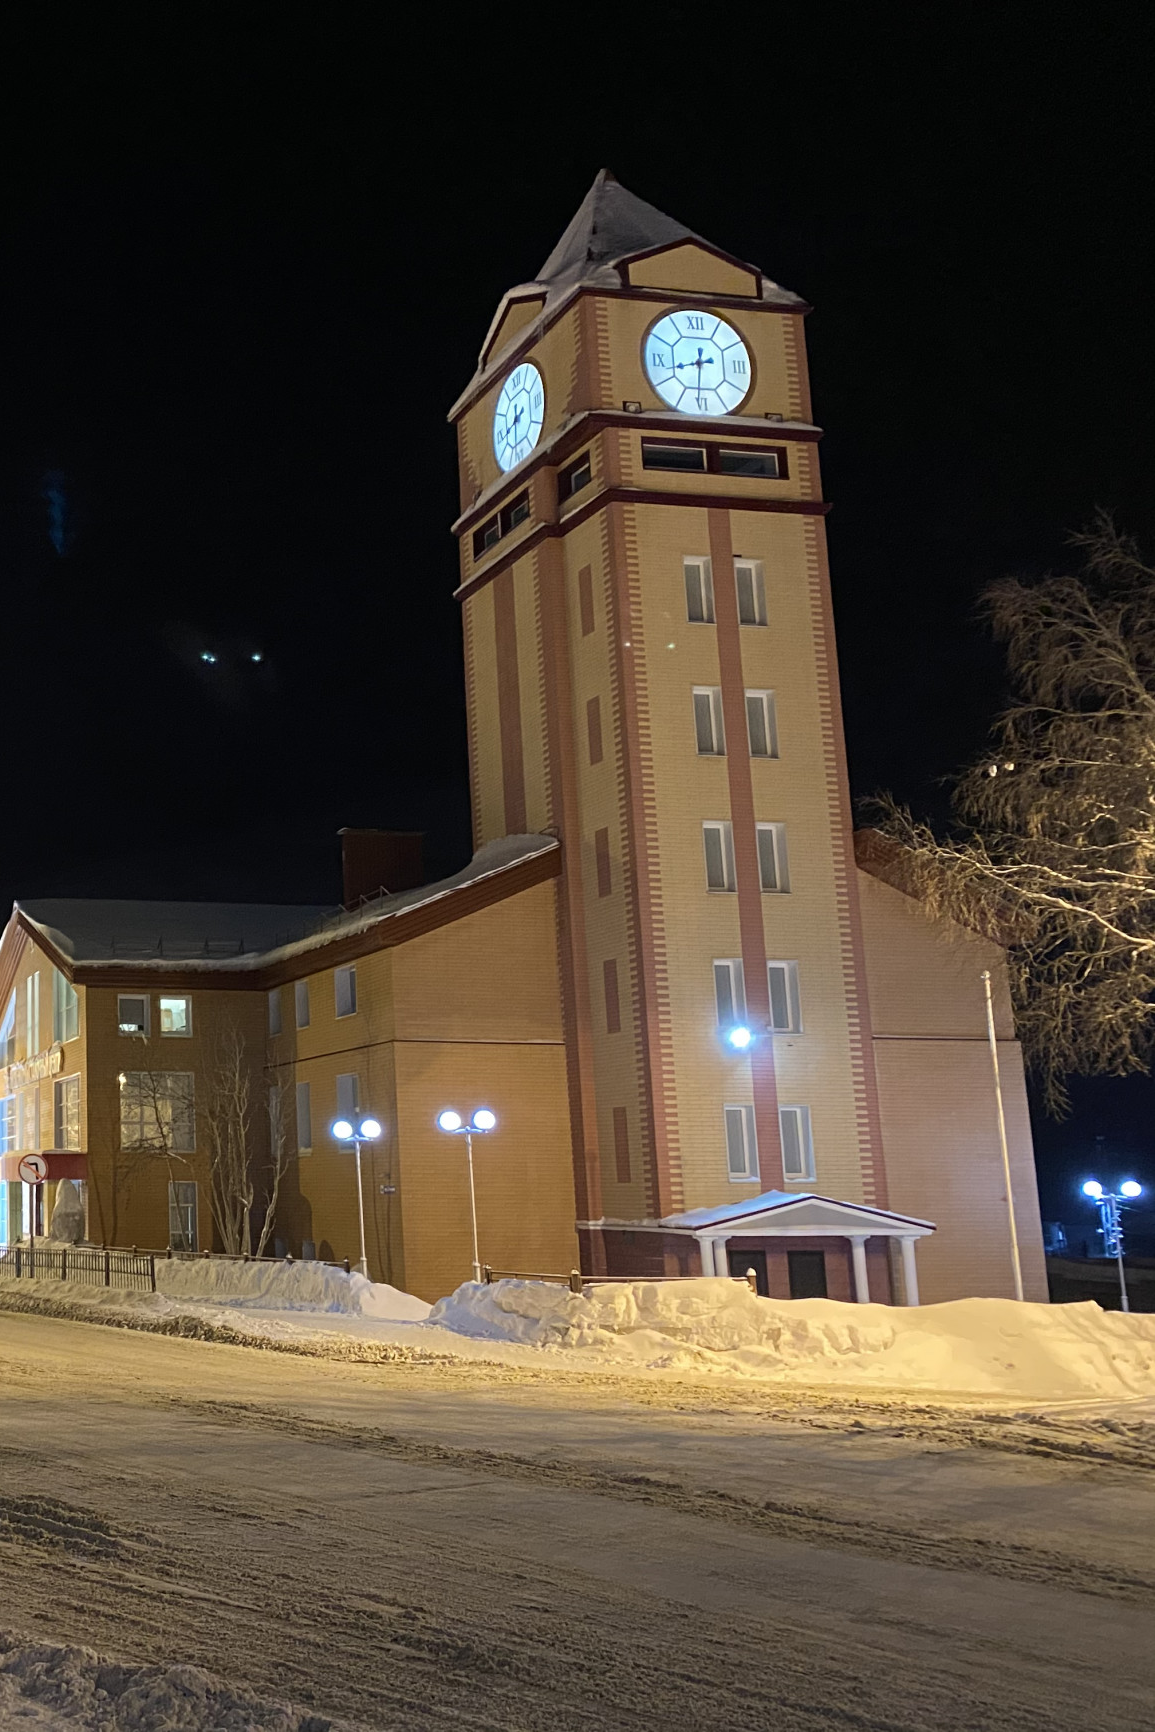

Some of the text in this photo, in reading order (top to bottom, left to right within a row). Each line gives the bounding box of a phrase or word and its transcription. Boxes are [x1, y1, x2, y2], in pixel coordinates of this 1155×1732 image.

[687, 316, 704, 330] XII
[652, 353, 665, 367] IX
[732, 360, 747, 374] III
[512, 372, 520, 390] XII
[534, 392, 542, 409] III
[695, 397, 708, 411] VI
